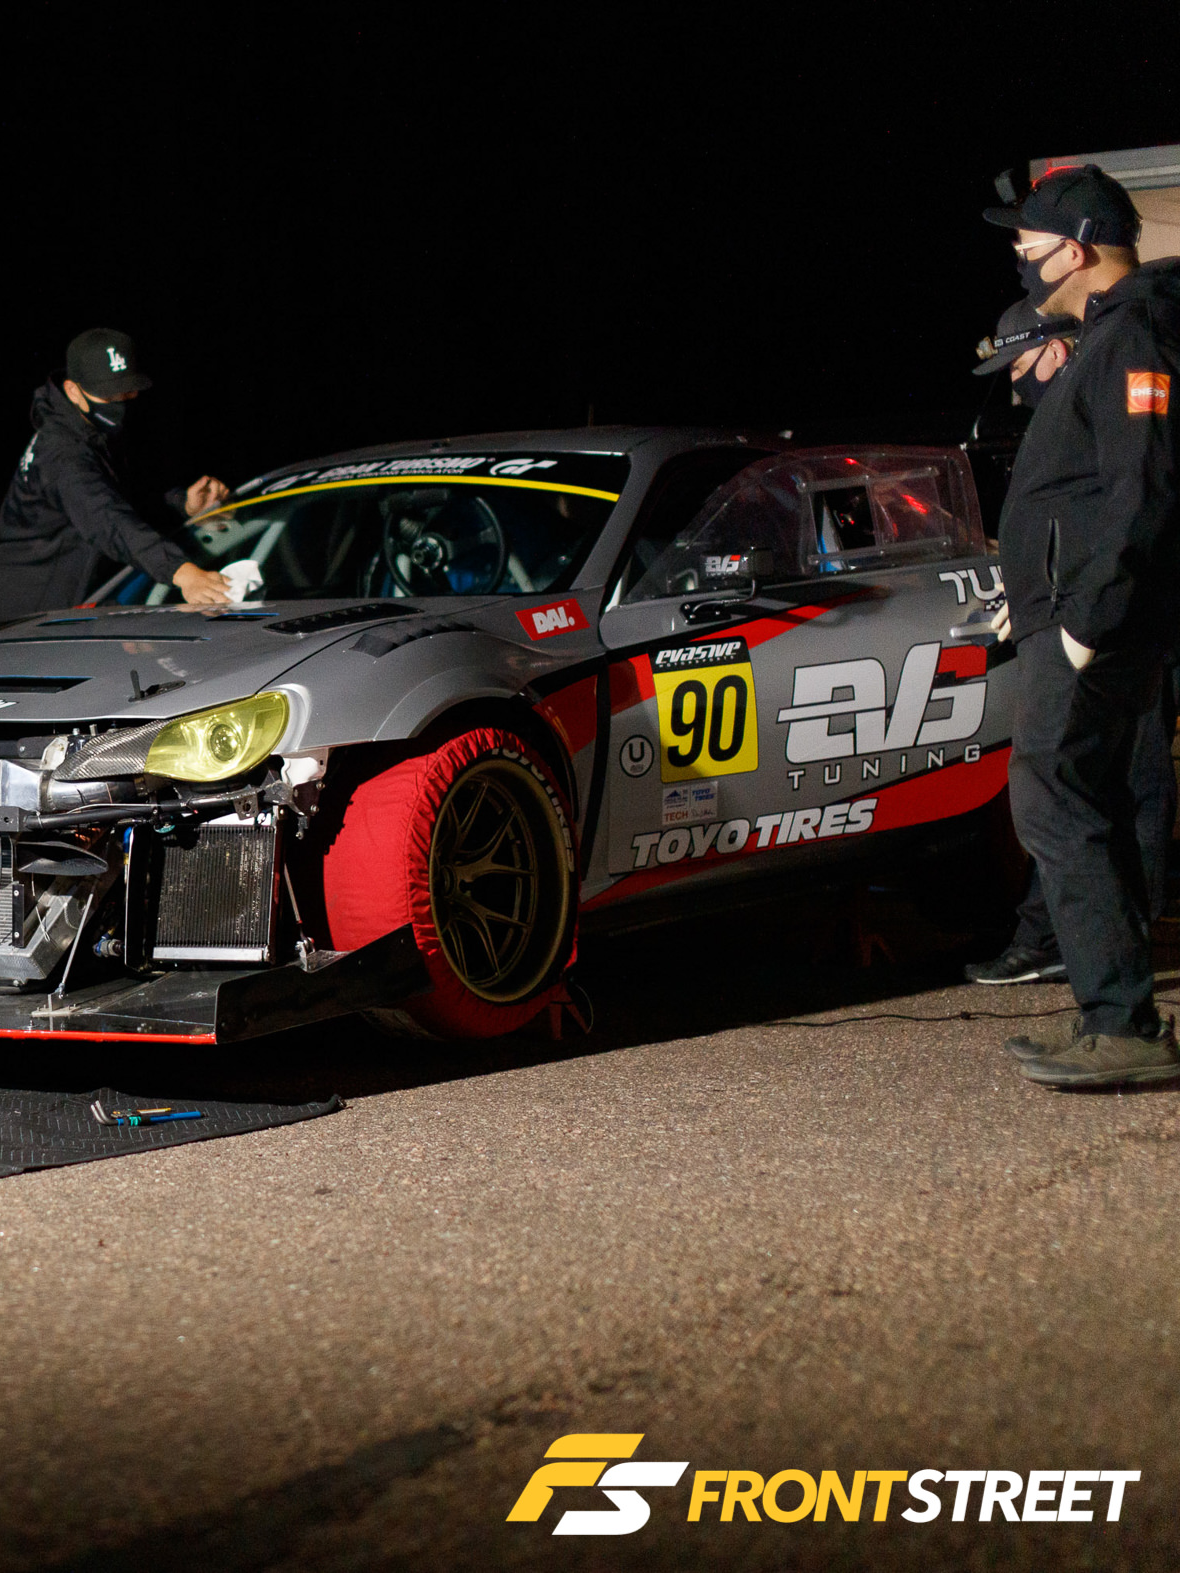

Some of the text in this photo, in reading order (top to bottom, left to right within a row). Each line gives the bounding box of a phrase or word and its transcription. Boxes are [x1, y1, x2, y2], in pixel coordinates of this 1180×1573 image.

[1005, 331, 1031, 344] COAST
[106, 347, 127, 372] LA
[667, 674, 748, 768] 90
[787, 743, 982, 791] TUNING
[631, 798, 879, 869] TOYO TIRES
[664, 810, 689, 821] TECH
